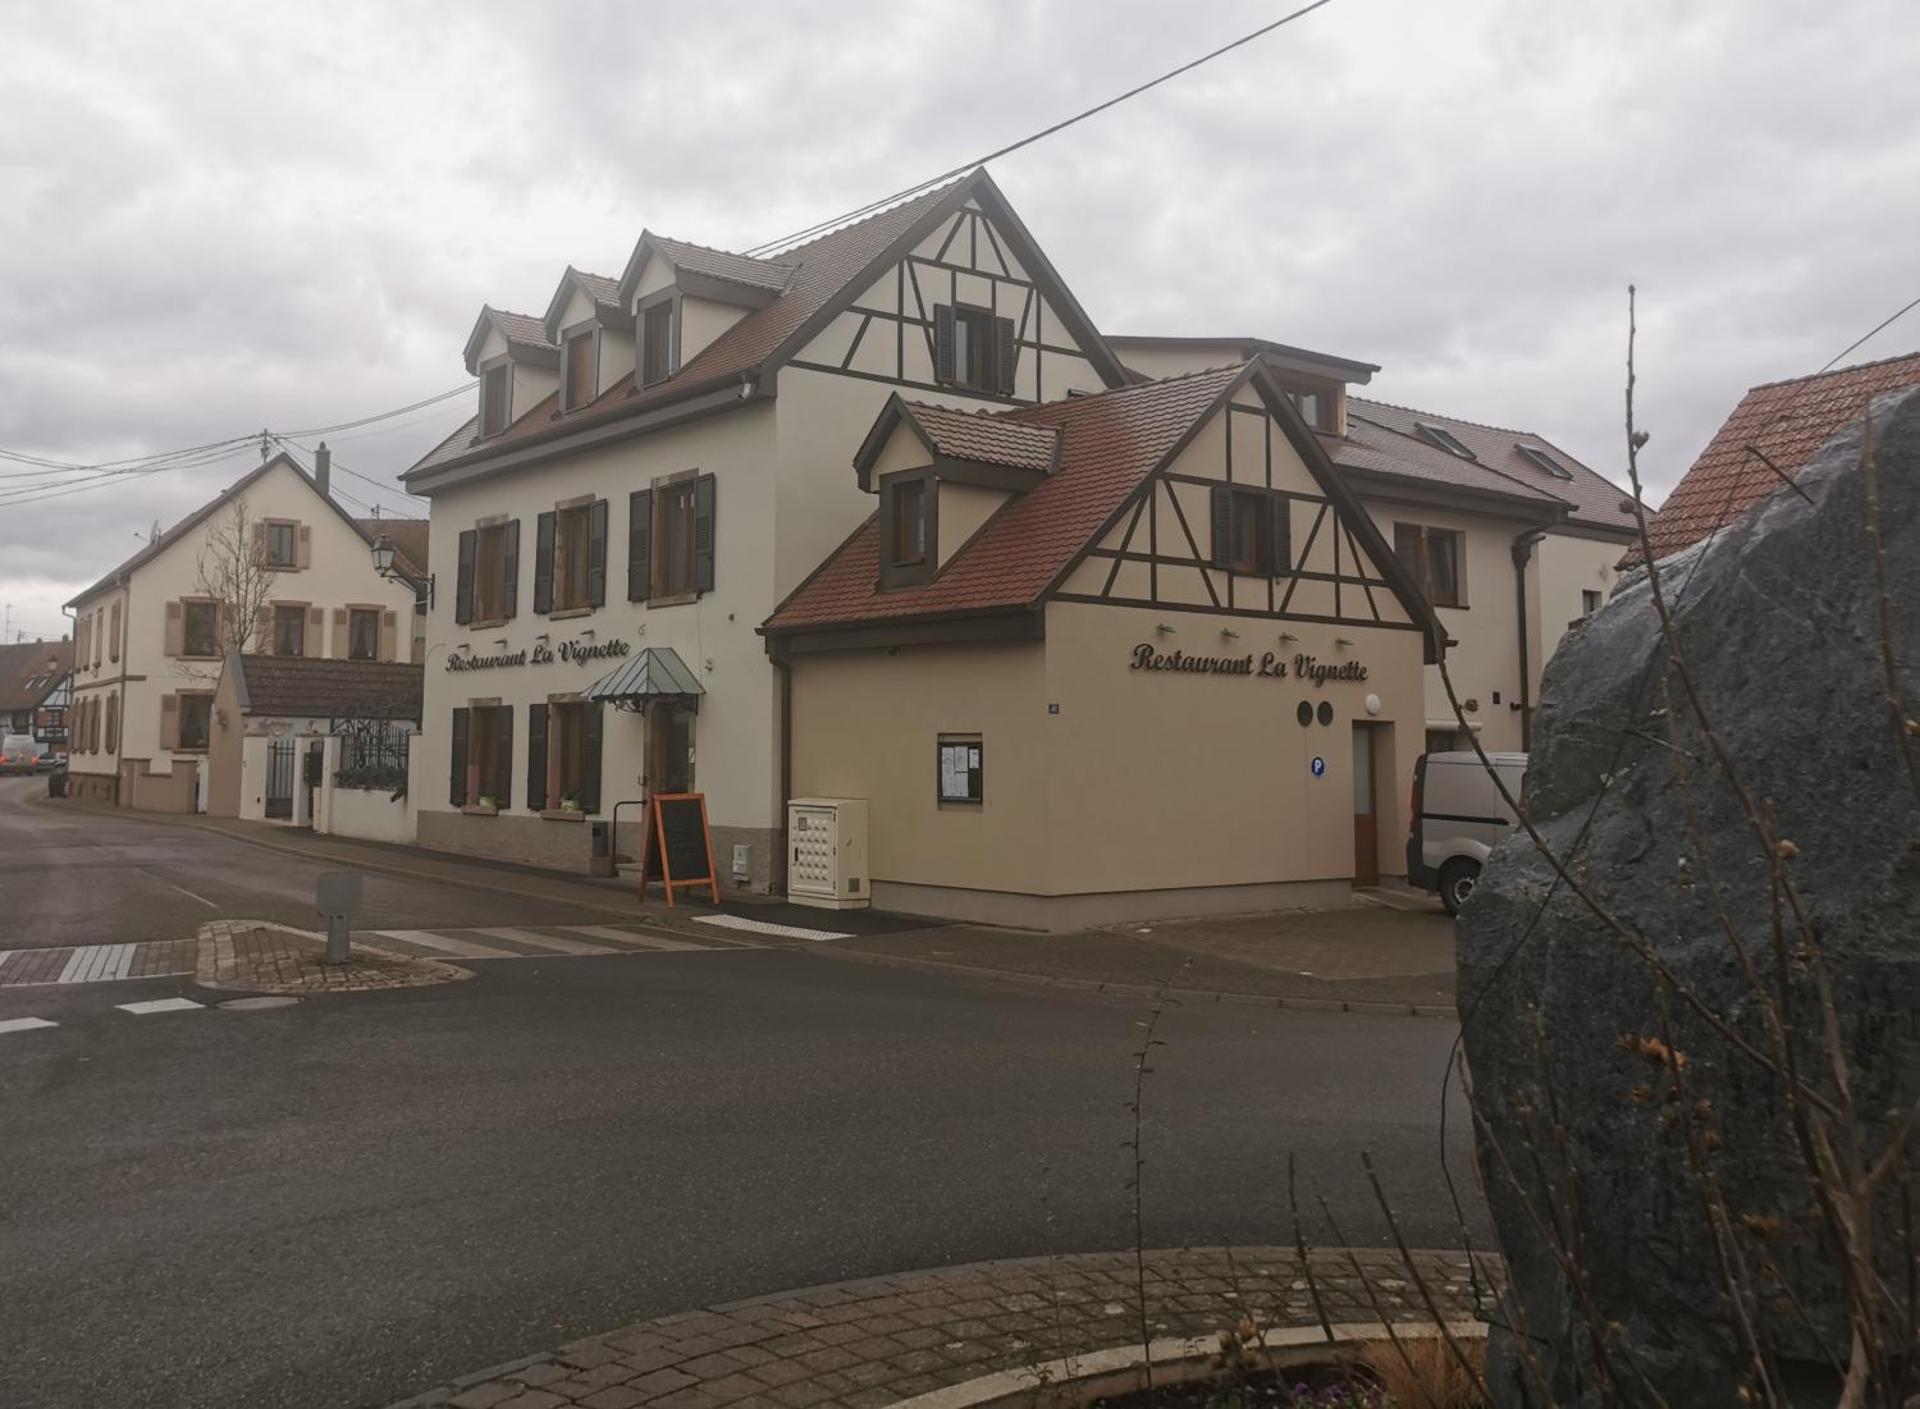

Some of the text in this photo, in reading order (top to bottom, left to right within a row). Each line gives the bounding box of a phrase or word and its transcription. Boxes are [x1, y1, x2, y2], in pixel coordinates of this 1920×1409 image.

[446, 639, 629, 671] Restaurant La Vignette
[1130, 643, 1368, 688] Restaurant La Vignette
[1314, 759, 1322, 773] P
